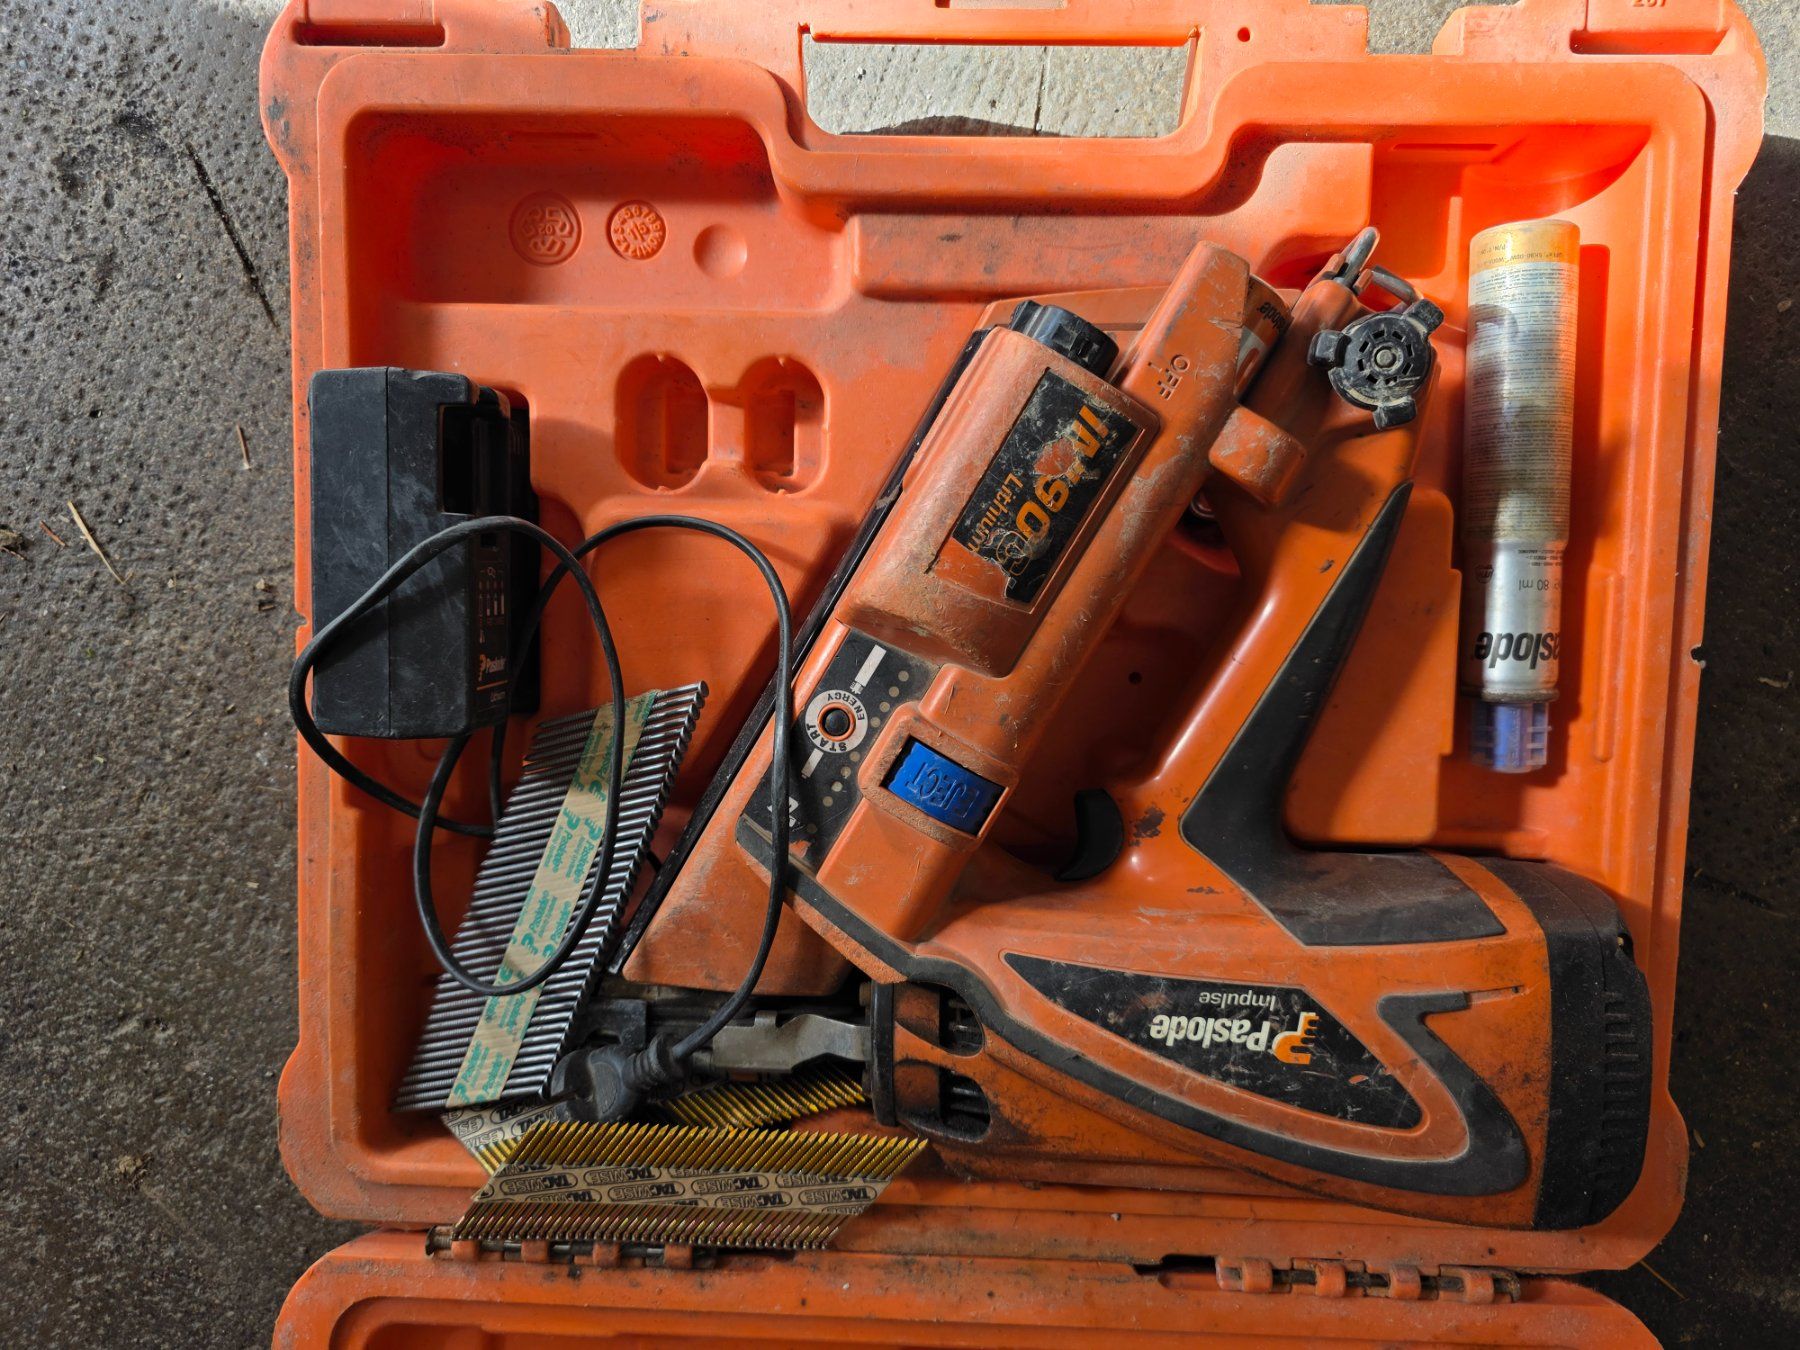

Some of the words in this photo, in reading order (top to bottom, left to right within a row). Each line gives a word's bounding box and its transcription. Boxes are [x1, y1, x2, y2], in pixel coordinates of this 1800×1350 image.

[1157, 354, 1191, 401] OFF
[967, 472, 1023, 553] Lithium
[1537, 578, 1550, 591] 80
[1473, 631, 1559, 670] aslode
[827, 691, 866, 721] ENERGY
[806, 722, 847, 752] START
[904, 762, 981, 818] EJECT
[1198, 989, 1277, 1012] Impulse
[1150, 1013, 1271, 1050] Paslode
[507, 1173, 572, 1194] TACWISE
[614, 1181, 679, 1200] TACWISE
[697, 1175, 763, 1193] TACWISE
[804, 1186, 871, 1205] TACWISE
[721, 1191, 787, 1208] TACWISE
